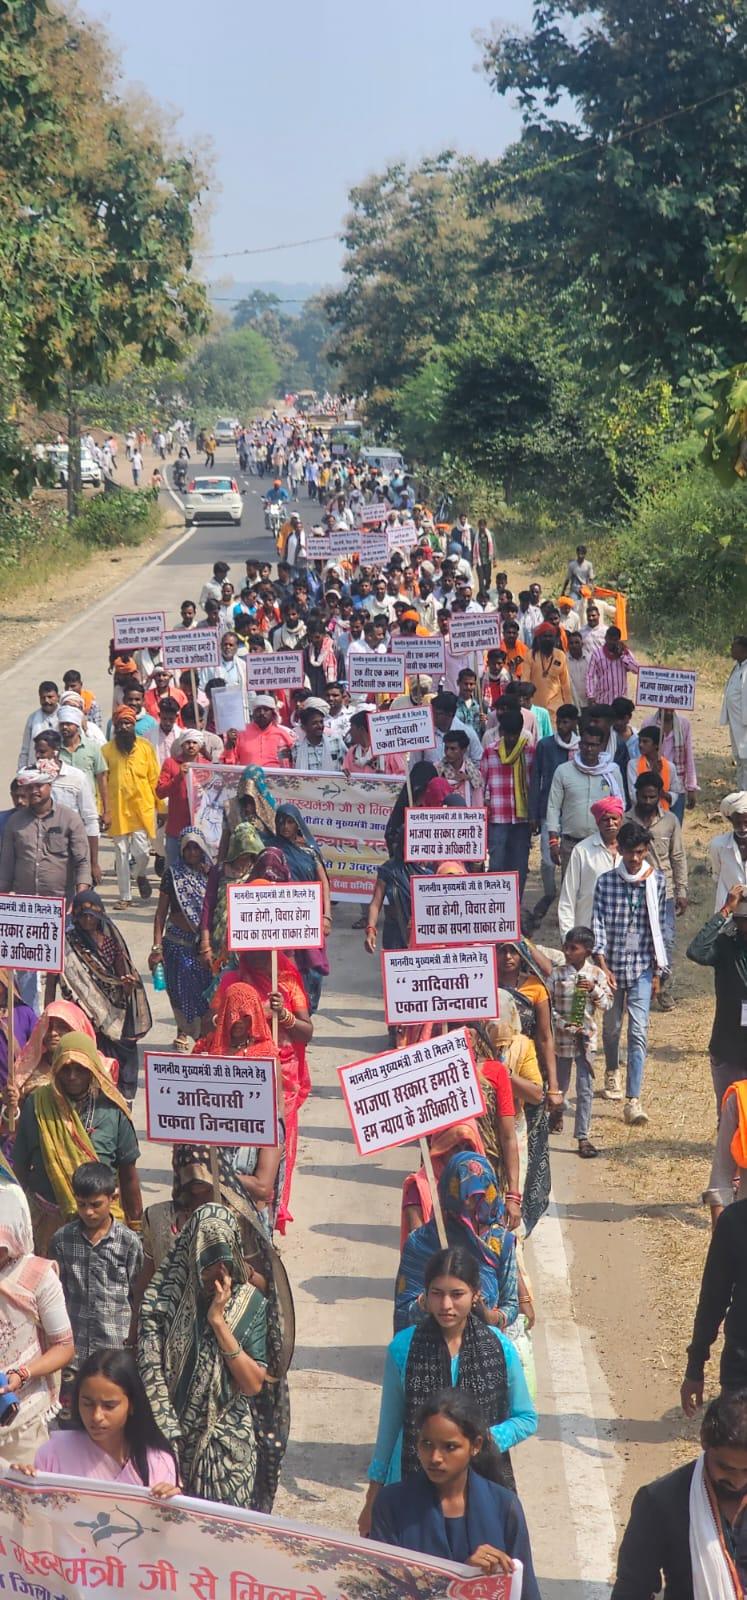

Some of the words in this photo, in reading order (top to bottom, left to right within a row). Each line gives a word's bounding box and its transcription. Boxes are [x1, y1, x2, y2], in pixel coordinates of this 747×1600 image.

[338, 802, 352, 812] जी
[410, 828, 432, 839] भाजपा
[434, 828, 454, 839] सरकार
[457, 826, 476, 839] हमारी
[476, 825, 482, 838] है
[410, 844, 420, 855] हम
[422, 844, 435, 854] न्याय
[437, 841, 443, 854] के
[472, 841, 477, 854] है
[18, 902, 26, 913] जी
[34, 903, 51, 914] मिलने
[240, 912, 253, 922] बात
[255, 908, 273, 924] होगी,
[275, 908, 294, 920] विचार
[295, 907, 310, 920] होगा
[426, 905, 440, 916] बात
[442, 900, 462, 918] होगी,
[465, 900, 486, 914] विचार
[488, 898, 505, 914] होगा
[26, 922, 50, 940] हमारी
[50, 922, 58, 940] है
[232, 930, 248, 940] न्याय
[250, 930, 259, 940] का
[261, 929, 280, 940] सपना
[282, 928, 302, 939] साकार
[304, 925, 318, 938] होगा
[417, 924, 435, 935] न्याय
[437, 924, 448, 934] का
[450, 923, 471, 934] सपना
[473, 922, 496, 933] साकार
[498, 917, 515, 932] होगा
[1, 940, 8, 958] के
[10, 942, 44, 962] अधिकारी
[44, 944, 51, 962] है
[390, 956, 414, 966] माननीय
[415, 954, 441, 968] मुख्यमंत्री
[442, 953, 450, 964] जी
[459, 952, 477, 963] मिलने
[412, 973, 469, 992] आदिवासी
[395, 1000, 428, 1013] एकता
[432, 996, 488, 1011] जिन्दाबाद
[349, 1067, 379, 1085] माननीय
[380, 1054, 412, 1079] मुख्यमंत्री
[412, 1050, 423, 1064] जी
[424, 1048, 432, 1060] से
[432, 1040, 455, 1058] मिलने
[456, 1038, 468, 1050] हेतु
[153, 1062, 180, 1074] माननीय
[182, 1064, 211, 1079] मुख्यमंत्री
[212, 1064, 222, 1077] जी
[224, 1065, 230, 1077] से
[232, 1065, 253, 1078] मिलने
[255, 1066, 266, 1082] हेतु
[354, 1090, 391, 1116] भाजपा
[392, 1078, 428, 1104] सरकार
[429, 1062, 460, 1090] हमारी
[458, 1058, 470, 1080] है
[177, 1088, 244, 1108] आदिवासी
[362, 1123, 379, 1142] हम
[379, 1114, 405, 1135] न्याय
[404, 1106, 416, 1127] के
[416, 1091, 459, 1123] अधिकारी
[457, 1086, 468, 1108] है
[158, 1114, 195, 1130] एकता
[200, 1113, 266, 1134] जिन्दाबाद
[10, 1539, 126, 1588] मुख्यमंत्री
[138, 1560, 178, 1591] जी
